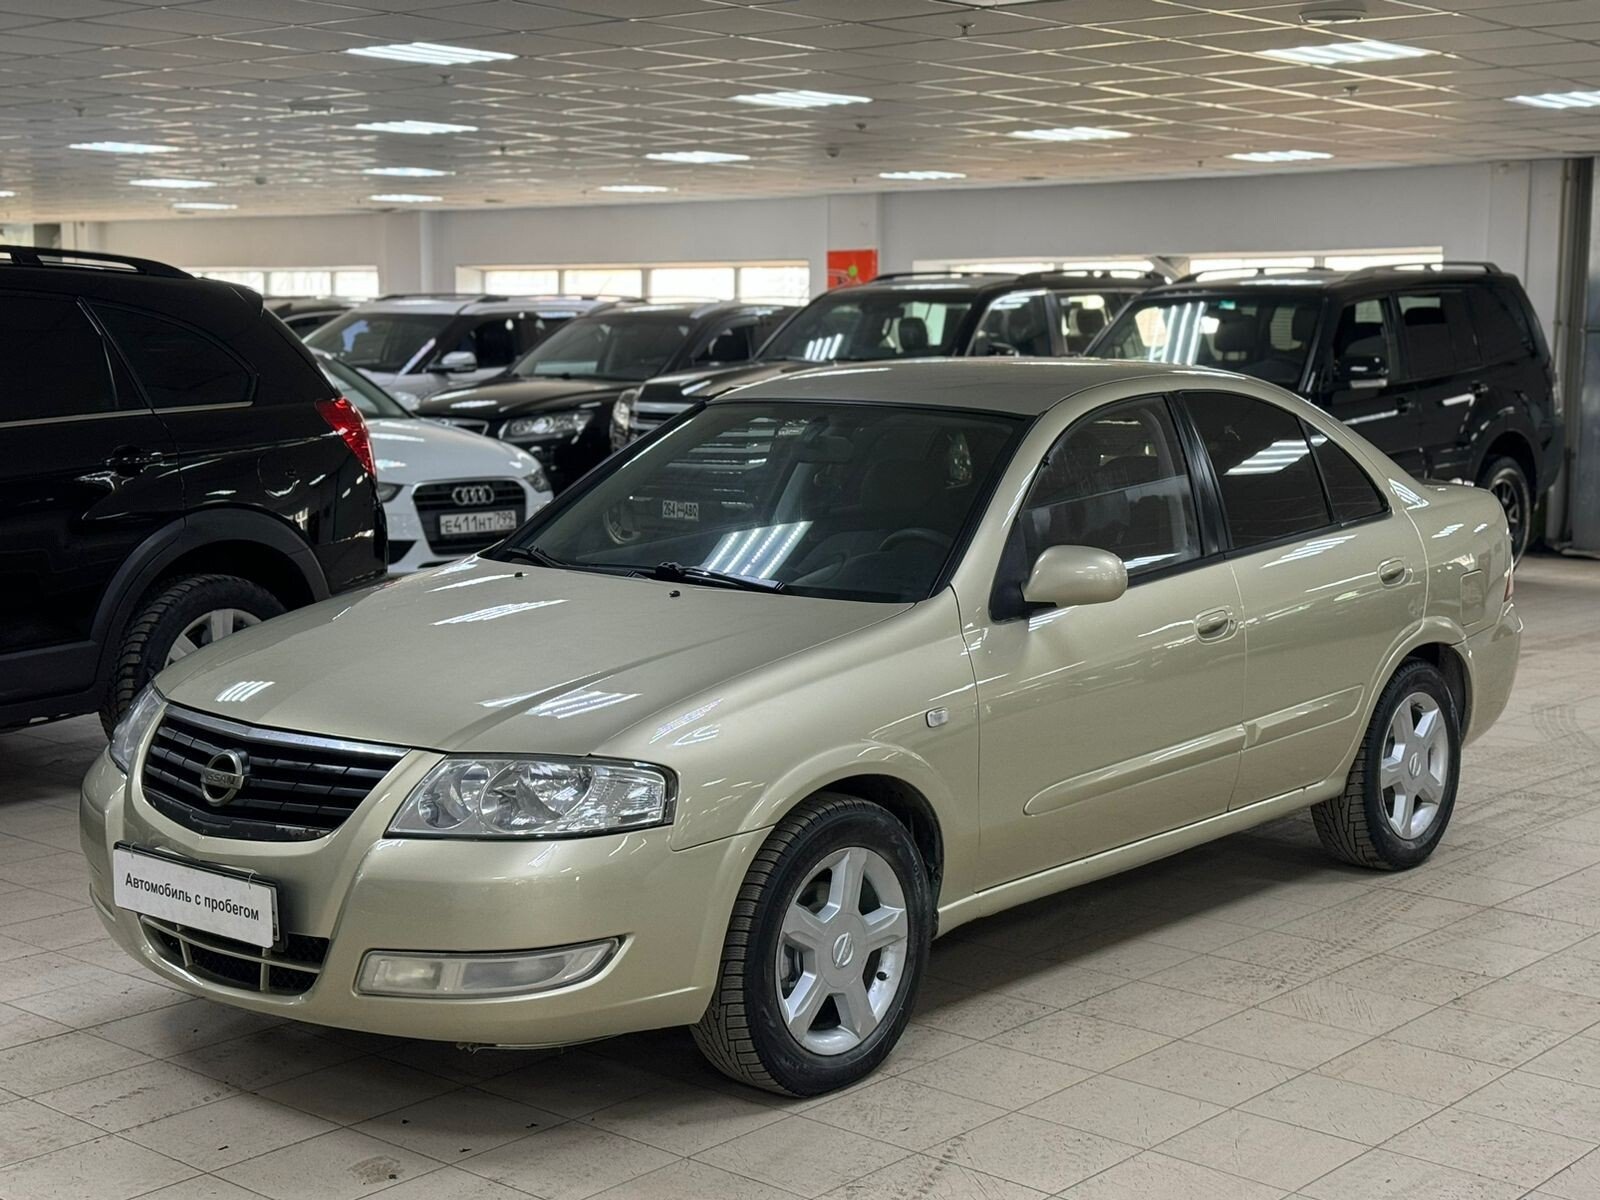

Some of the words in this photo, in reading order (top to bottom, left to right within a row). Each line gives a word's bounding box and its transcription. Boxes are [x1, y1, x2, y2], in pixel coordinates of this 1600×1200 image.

[125, 873, 192, 902] Автомобиль
[194, 894, 202, 905] с
[204, 896, 260, 921] пробегом
